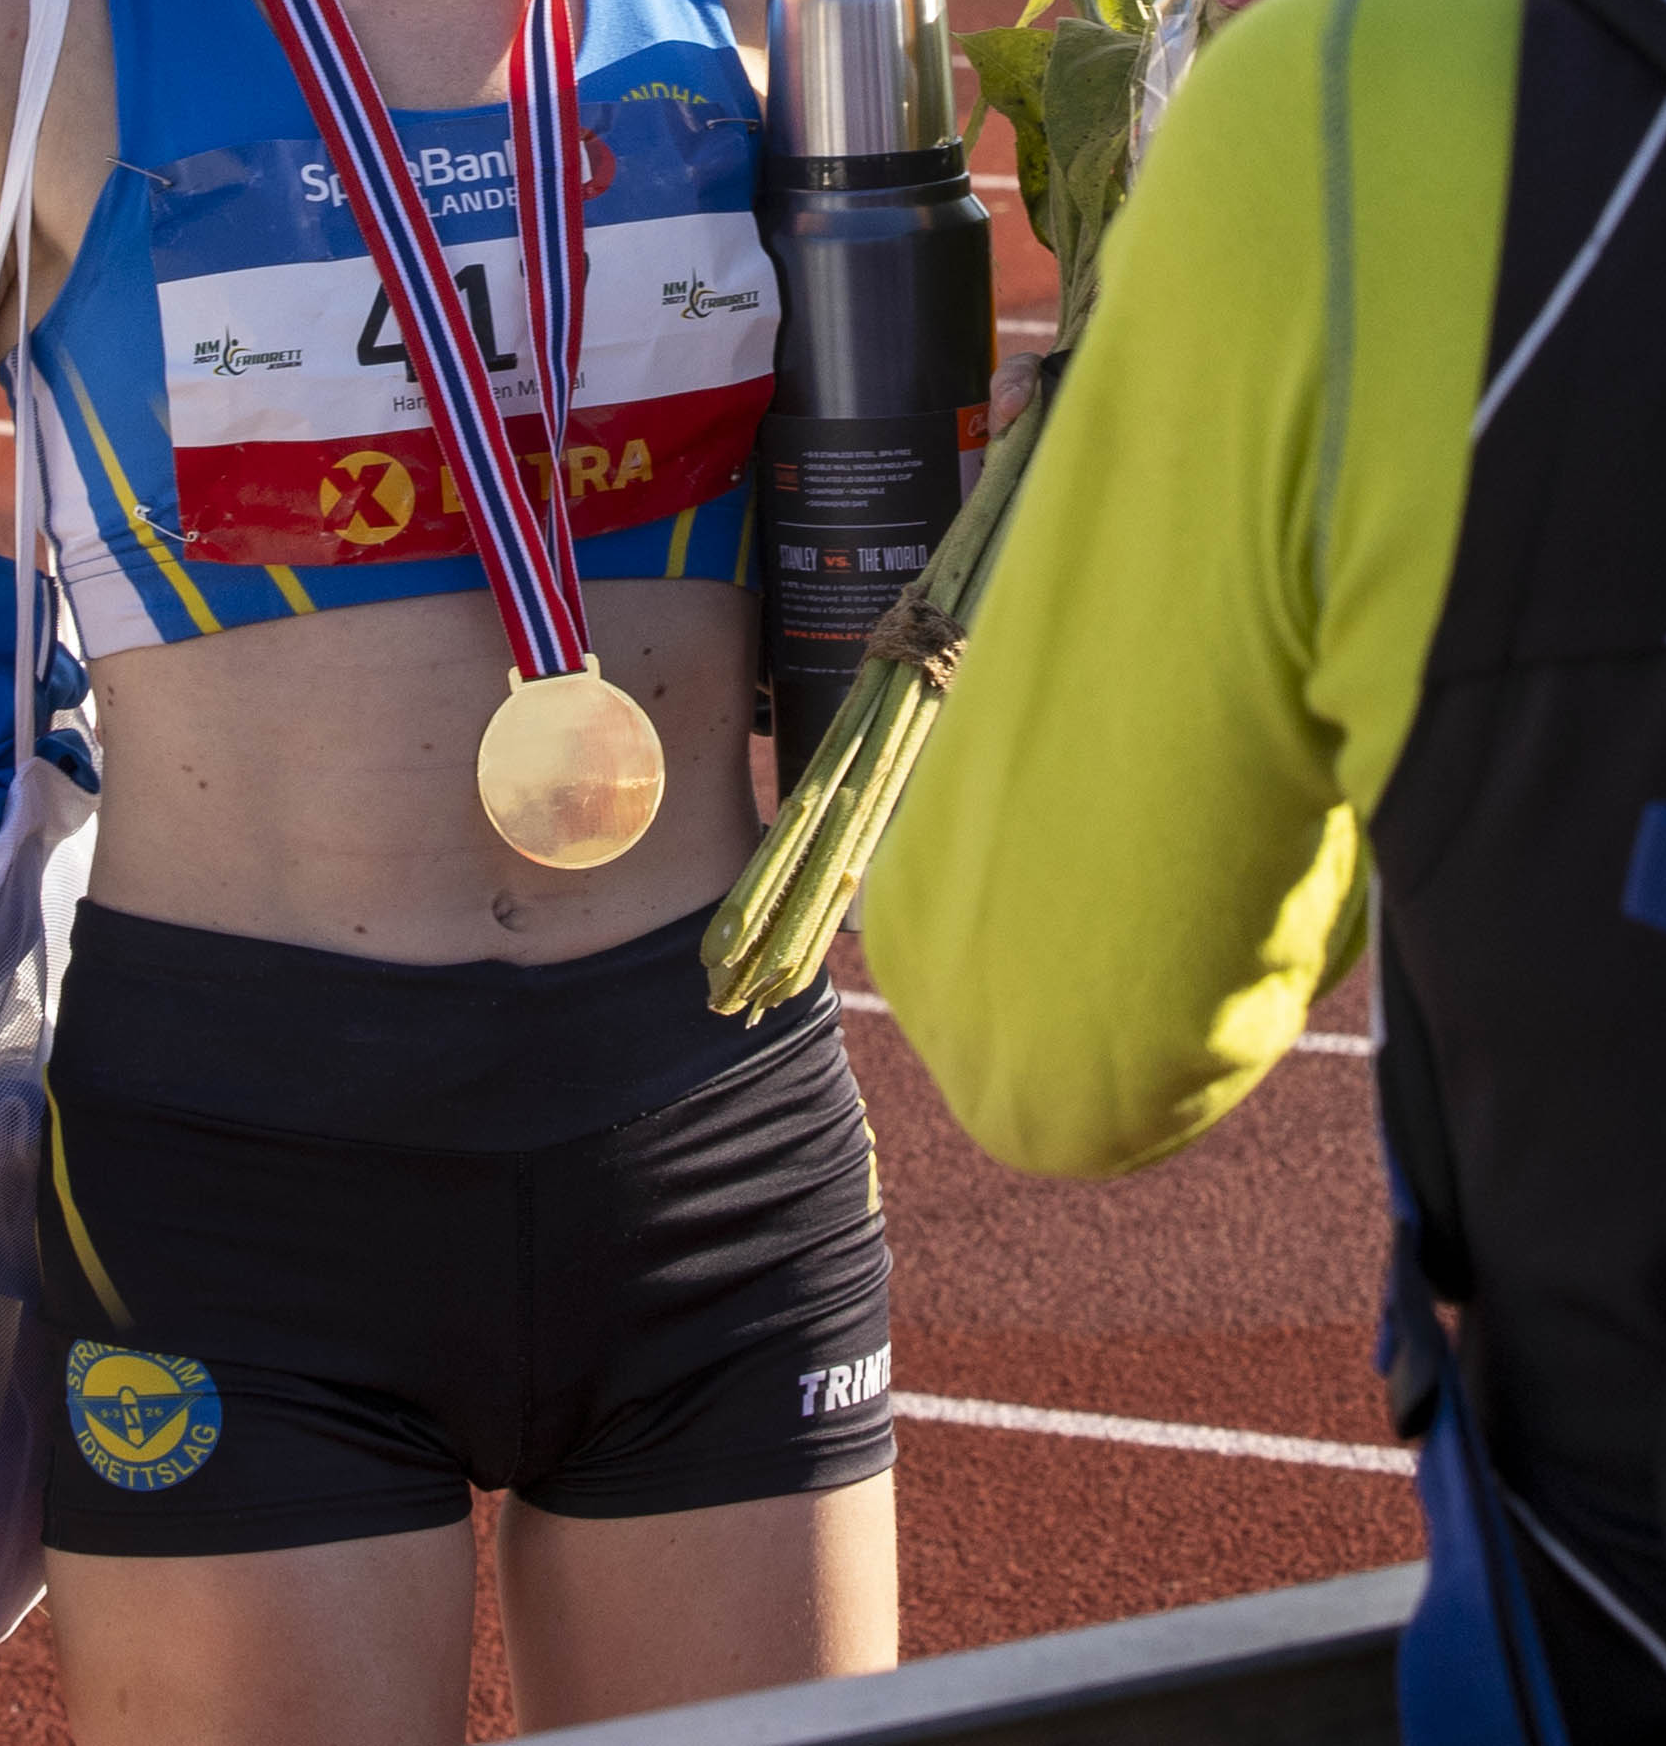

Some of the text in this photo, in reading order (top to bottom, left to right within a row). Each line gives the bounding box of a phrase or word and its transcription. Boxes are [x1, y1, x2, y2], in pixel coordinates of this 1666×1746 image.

[662, 280, 688, 296] NM
[195, 339, 221, 356] NM
[235, 349, 303, 368] FRIIDRETT
[856, 547, 882, 572] THE
[77, 1424, 216, 1488] IDRETTSLAG
